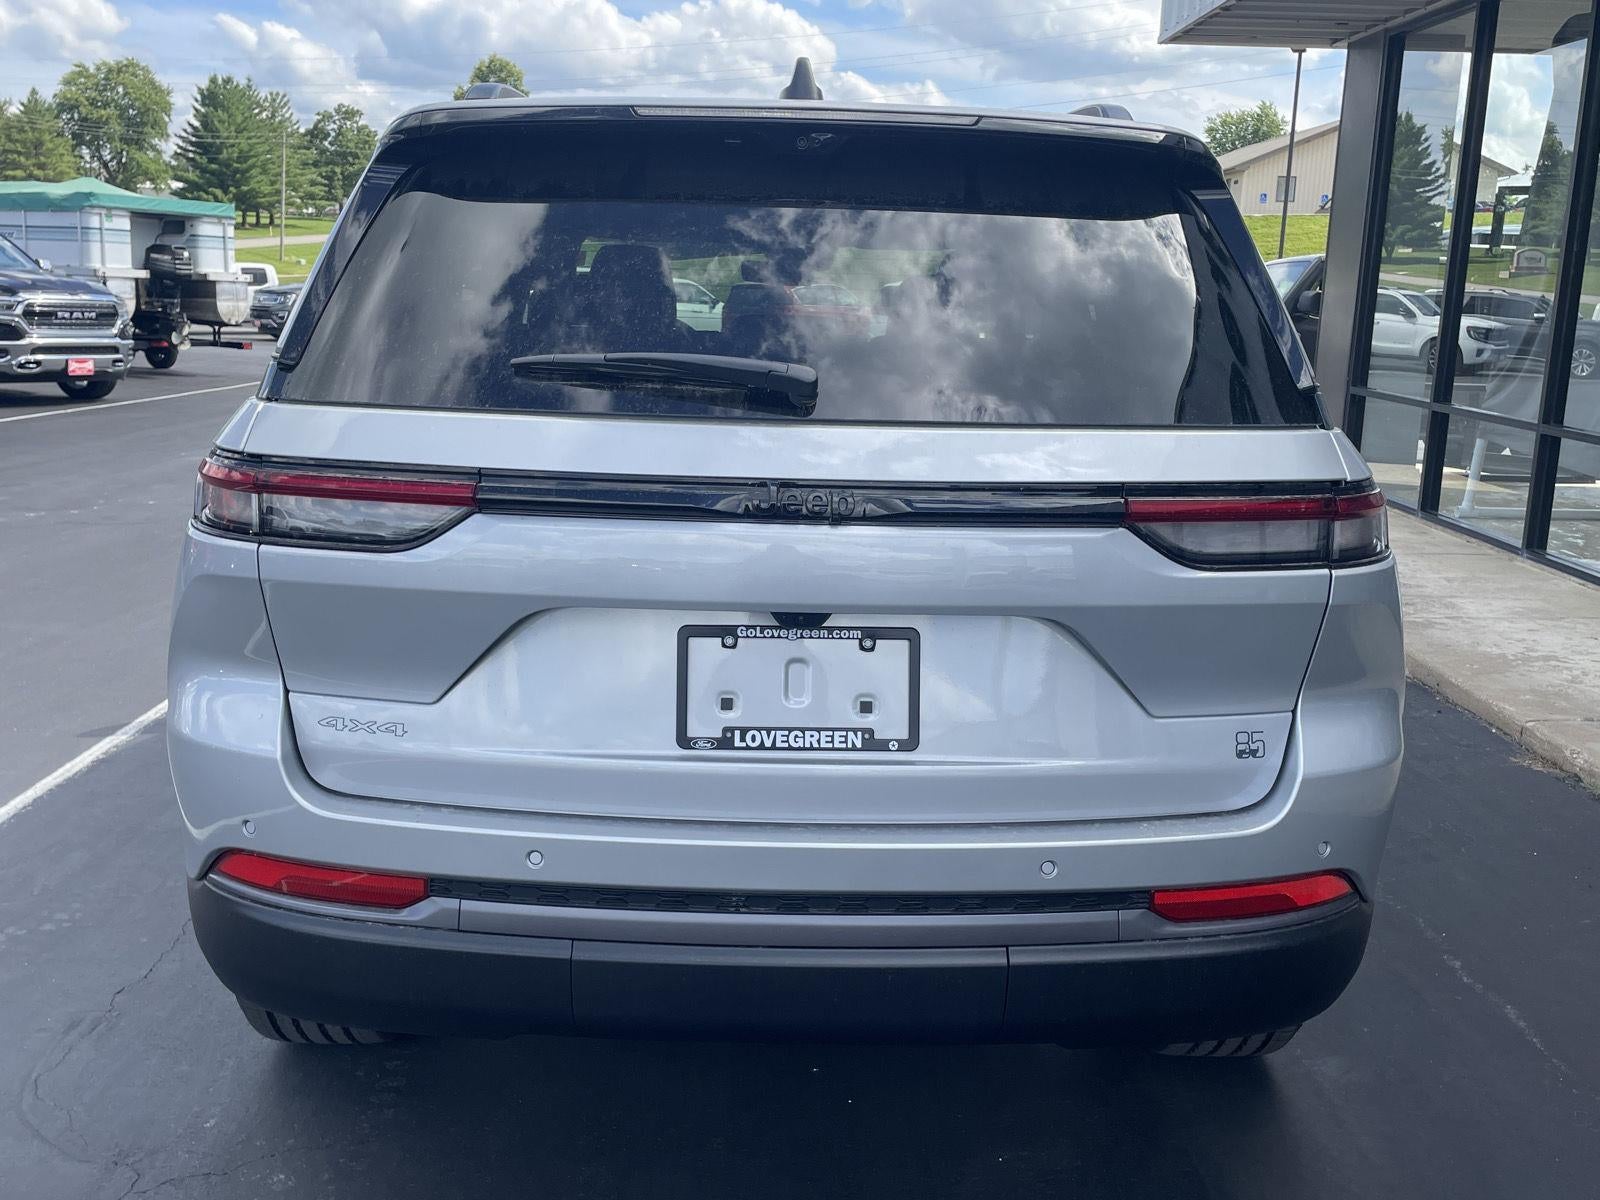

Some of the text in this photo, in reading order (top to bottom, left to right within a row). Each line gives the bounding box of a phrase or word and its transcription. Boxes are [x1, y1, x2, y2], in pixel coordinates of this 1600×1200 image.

[56, 311, 97, 320] RAM
[752, 481, 856, 525] Jeep
[736, 626, 862, 641] GoLovegreen.com
[734, 730, 862, 748] LOVEGREEN
